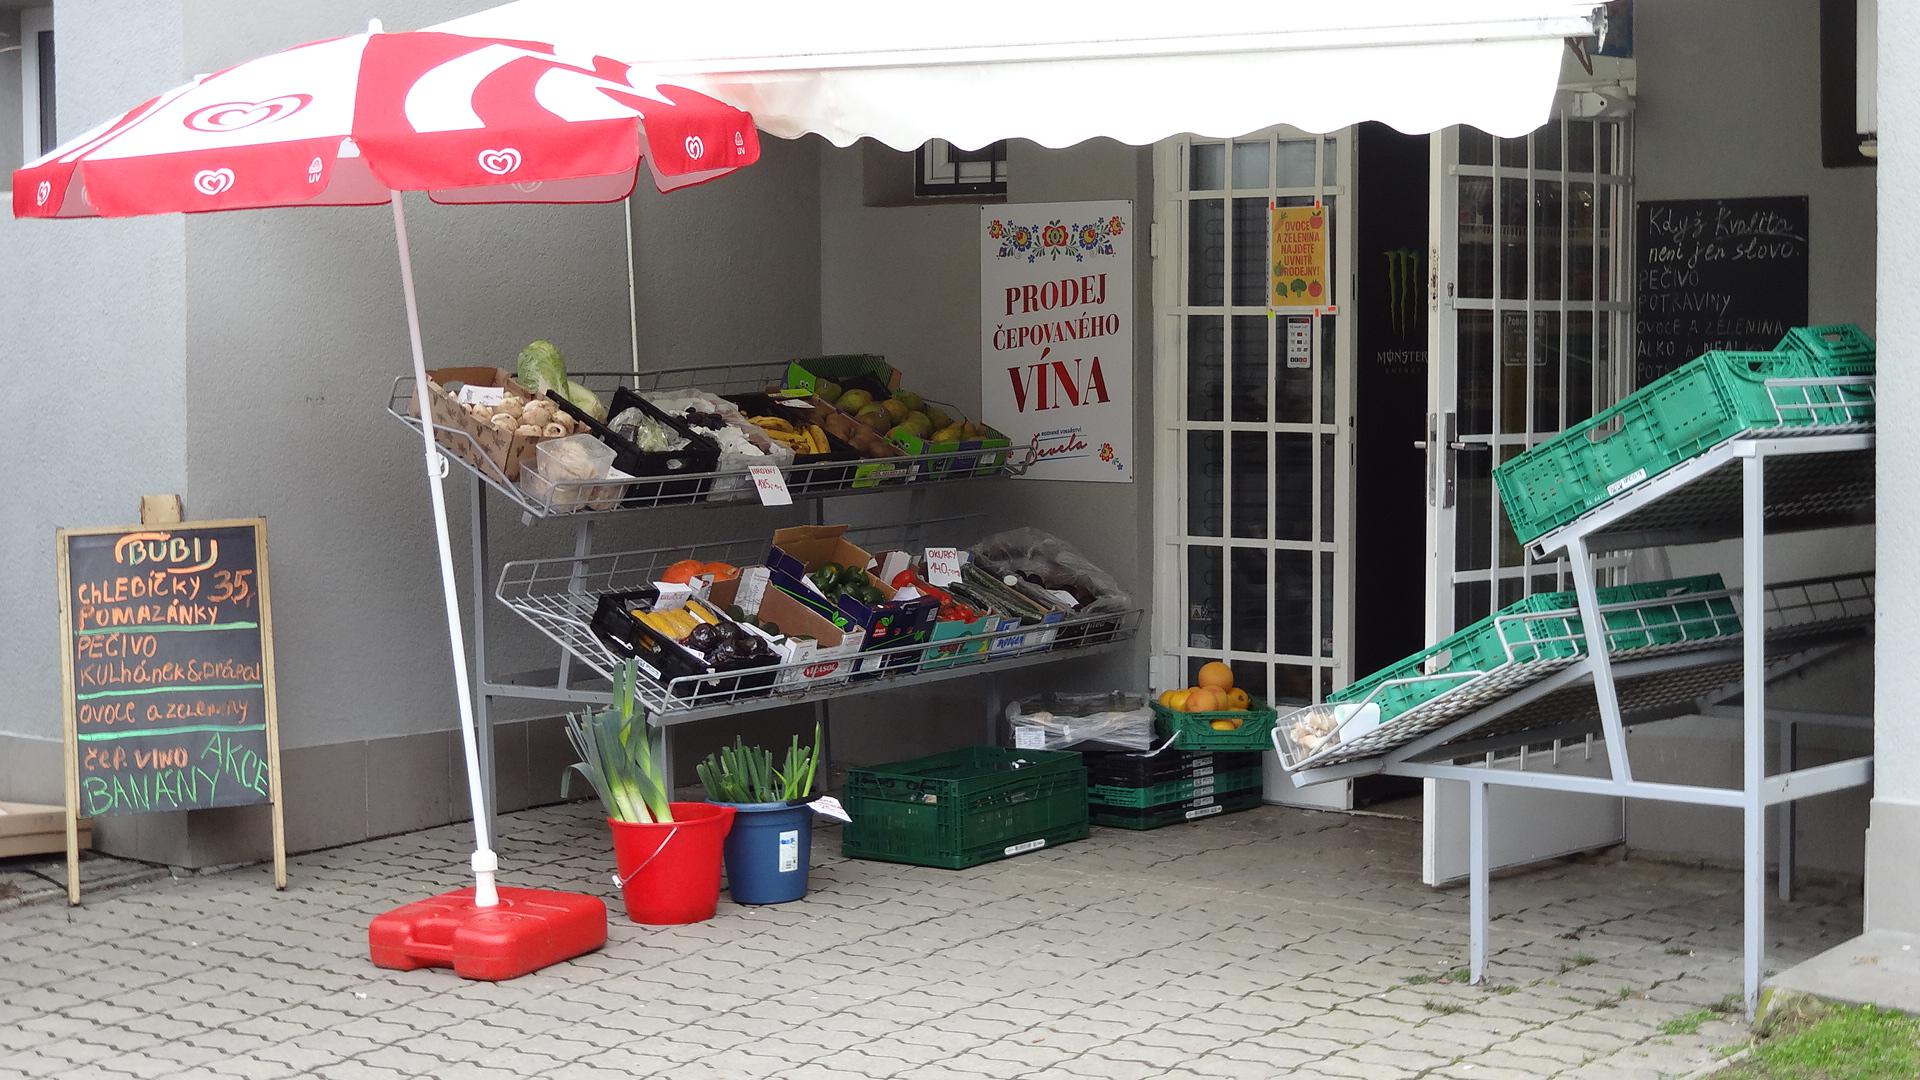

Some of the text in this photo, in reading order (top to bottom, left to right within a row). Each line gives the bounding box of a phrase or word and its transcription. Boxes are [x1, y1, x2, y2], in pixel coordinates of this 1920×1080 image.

[308, 172, 322, 184] UV
[1283, 232, 1320, 244] ZELENINA
[1285, 221, 1310, 232] OVOCE
[1281, 243, 1315, 255] NAJDETE
[1638, 265, 1699, 291] PEČIVO
[1004, 272, 1108, 316] PRODEJ
[992, 311, 1120, 351] ČEPOVANÉHO
[1007, 346, 1111, 413] VÍNA
[78, 632, 158, 660] PEČIVO
[201, 732, 269, 798] AKCE
[82, 765, 221, 816] BANÁNY
